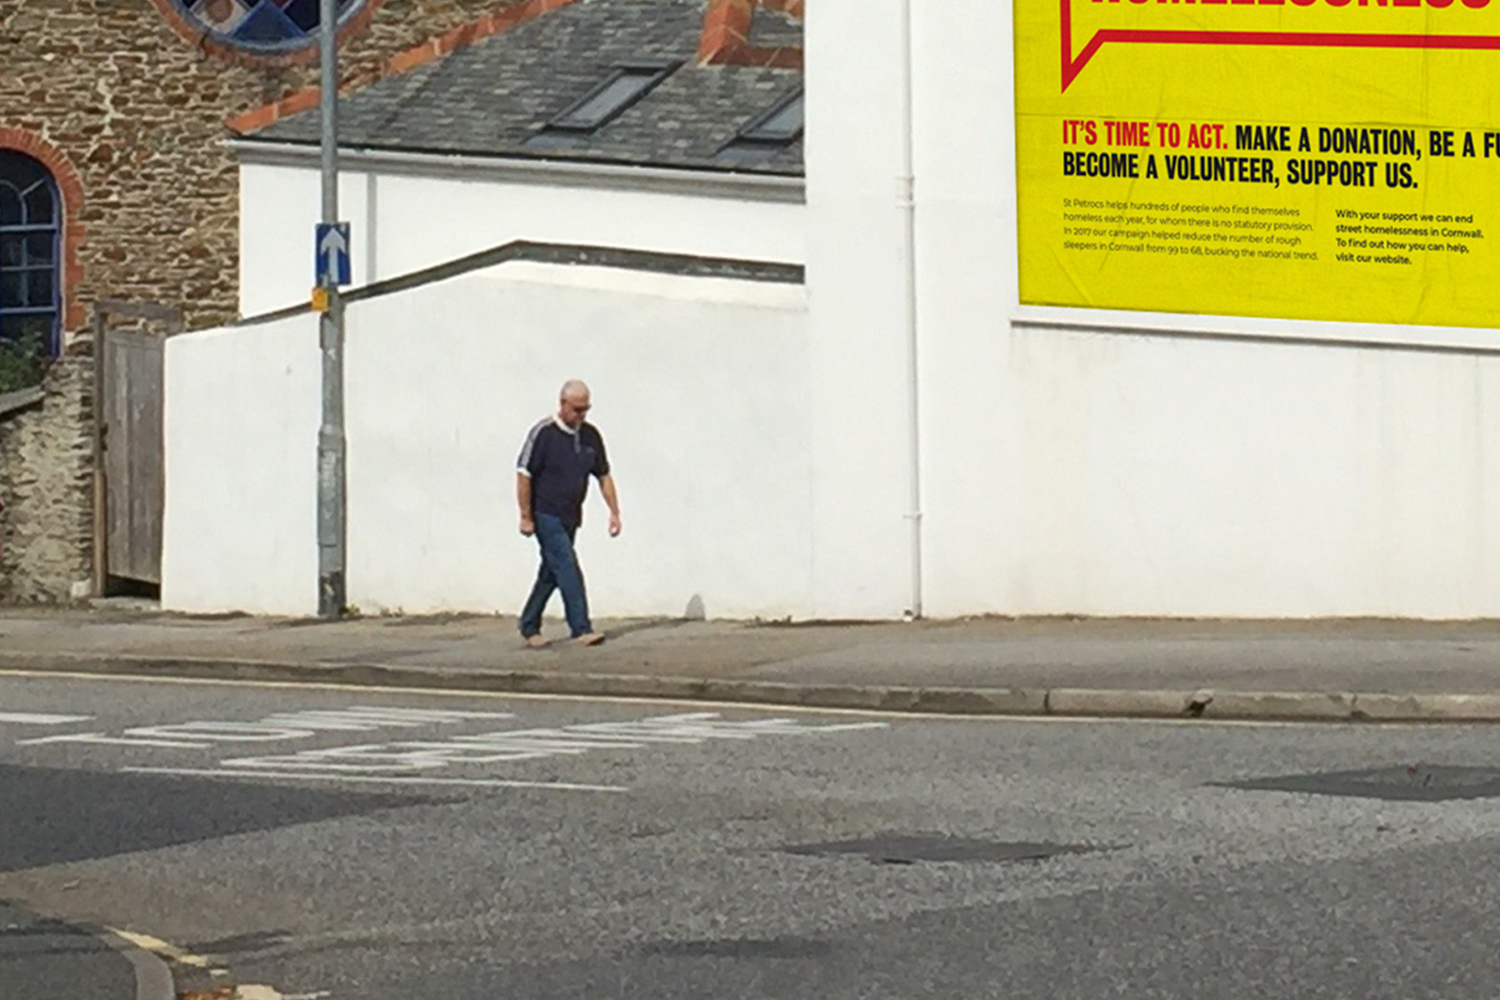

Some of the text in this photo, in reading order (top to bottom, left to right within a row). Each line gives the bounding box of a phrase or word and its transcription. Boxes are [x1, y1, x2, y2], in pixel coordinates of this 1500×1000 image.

[1103, 120, 1150, 148] TIME
[1156, 121, 1181, 149] TO
[1187, 122, 1228, 151] ACT.
[1235, 124, 1291, 153] MAKE
[1298, 126, 1311, 153] A
[1318, 126, 1421, 160] DONATION,
[1429, 129, 1455, 158] BE
[1462, 130, 1476, 158] A
[1063, 151, 1418, 190] BECOME A VOLUNTEER, SUPPORT US.
[1063, 198, 1300, 216] St Petrocs helps hundreds of people who find themselves
[1335, 209, 1473, 224] With your support we can end
[1063, 212, 1314, 234] homeless each year, for whom there is no statutory provision.
[1335, 223, 1484, 238] street homelessness in Cornwall.
[1064, 226, 1071, 235] In
[1092, 229, 1107, 237] our
[1108, 227, 1149, 241] campaign
[1151, 229, 1180, 242] helped
[1182, 230, 1211, 241] reduce
[1213, 232, 1227, 241] the
[1229, 232, 1263, 243] number
[1265, 234, 1274, 243] of
[1275, 234, 1301, 247] rough
[1336, 238, 1469, 255] To find out how you can help,
[1063, 240, 1097, 253] sleepers
[1099, 241, 1107, 251] in
[1108, 242, 1144, 253] Cornwall
[1146, 243, 1166, 253] from
[1180, 245, 1189, 254] to
[1205, 246, 1240, 259] bucking
[1241, 247, 1255, 257] the
[1257, 248, 1291, 259] national
[1335, 252, 1412, 264] visit our website.
[14, 705, 518, 748] TOWN
[219, 712, 892, 771] CENTRE
